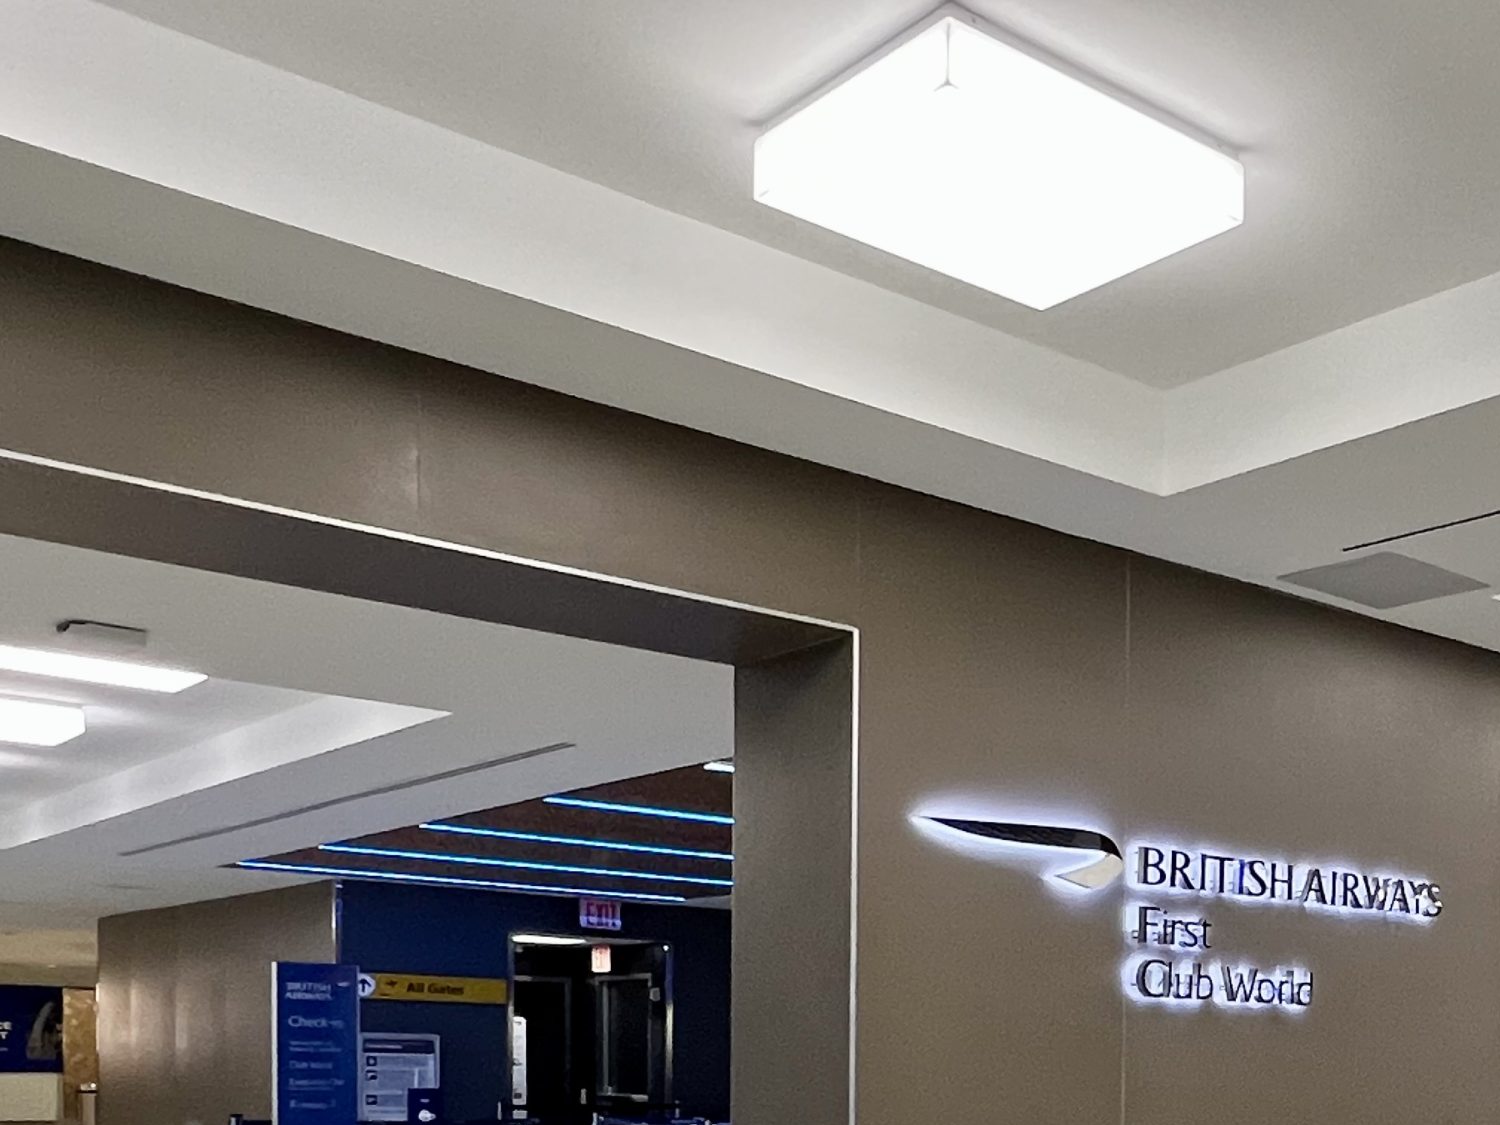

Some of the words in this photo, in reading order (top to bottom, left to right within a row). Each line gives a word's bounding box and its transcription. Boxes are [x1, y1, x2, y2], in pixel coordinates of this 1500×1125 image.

[1137, 846, 1294, 901] BRITISH
[1302, 868, 1444, 918] AIRWAYS
[1136, 906, 1212, 949] First
[406, 982, 425, 993] All
[1136, 959, 1214, 1001] Club
[1221, 966, 1314, 1006] World
